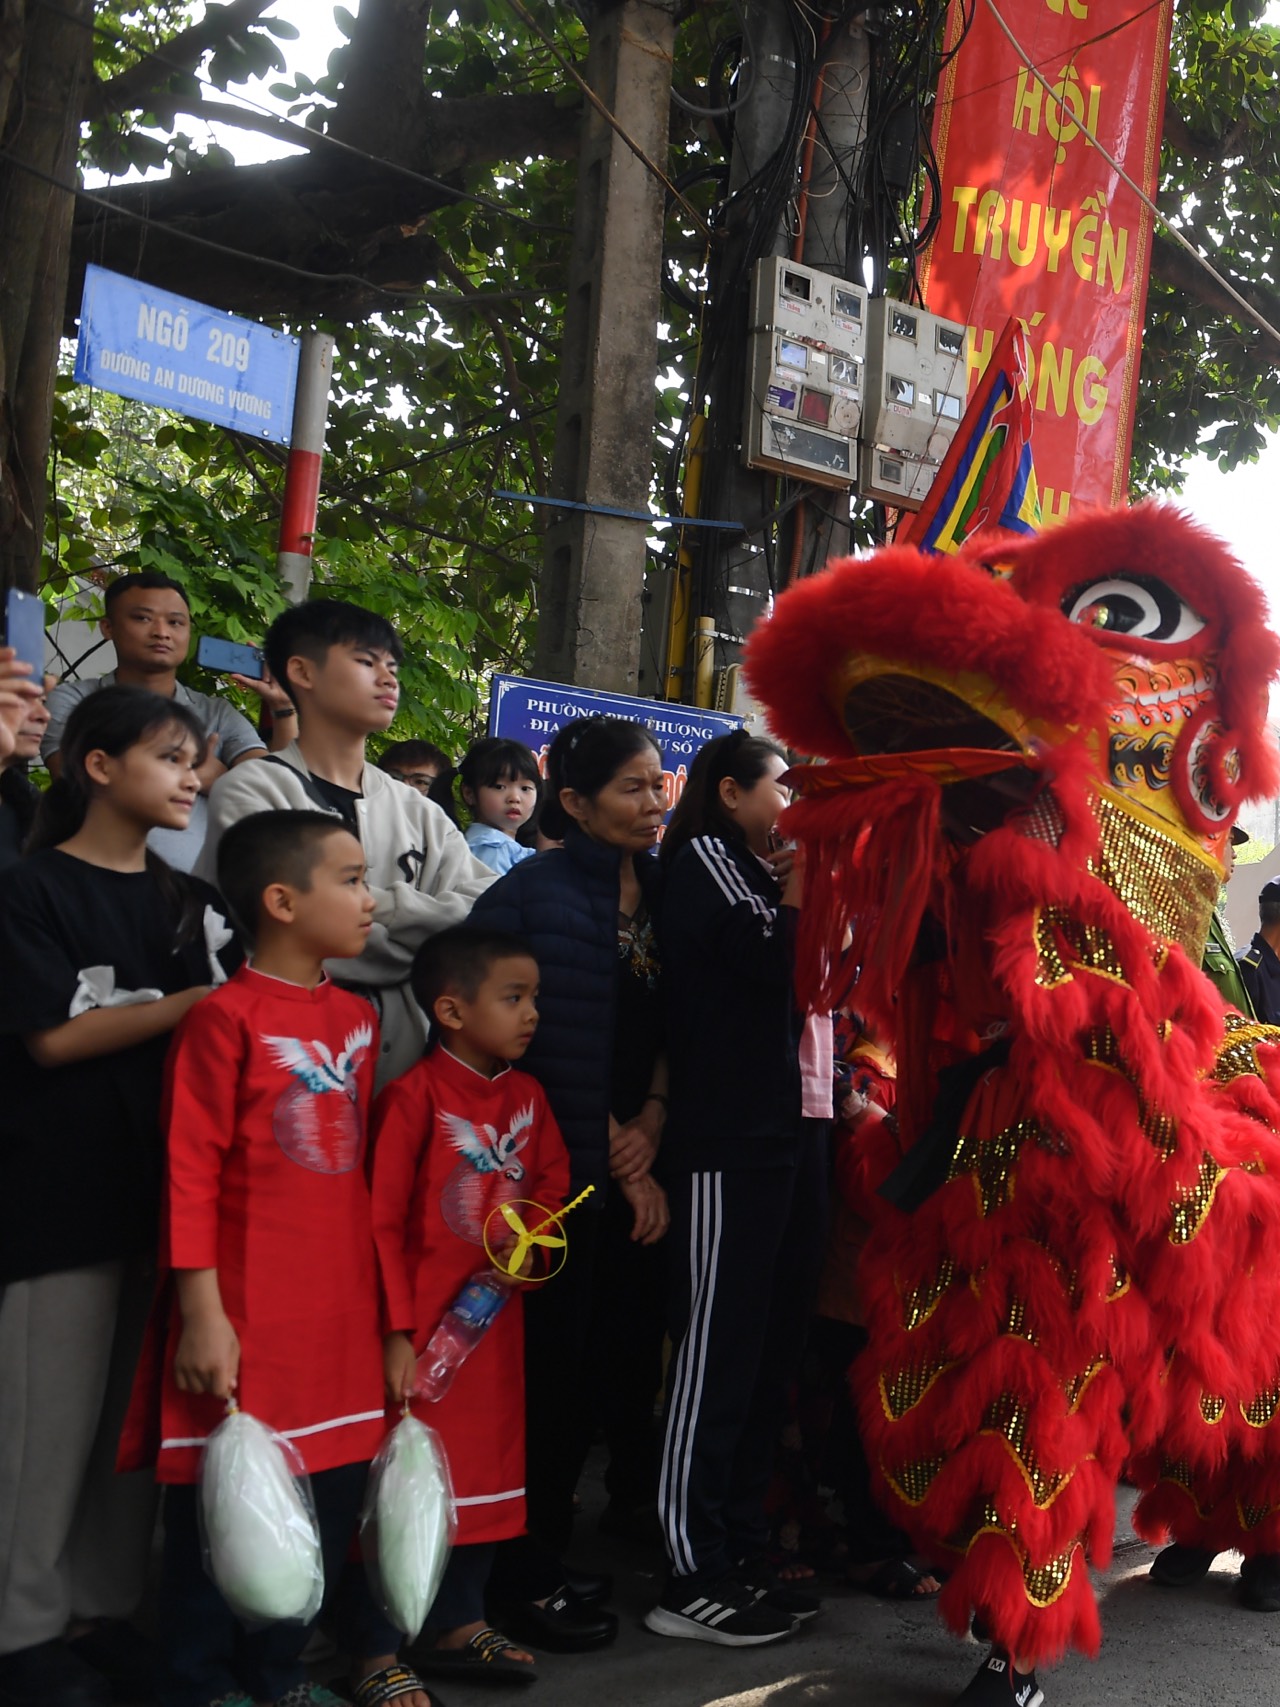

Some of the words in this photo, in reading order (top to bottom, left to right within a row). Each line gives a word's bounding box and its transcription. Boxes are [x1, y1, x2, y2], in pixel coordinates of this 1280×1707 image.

[1012, 65, 1101, 164] HỘI
[952, 186, 1128, 294] TRUYỀN
[137, 303, 189, 352] NGÕ
[206, 328, 250, 372] 209
[100, 349, 150, 381] ĐƯỜNG
[154, 367, 174, 390] AN
[178, 374, 225, 405] DƯƠNG
[229, 389, 272, 419] VƯƠNG
[527, 698, 601, 718] PHƯỜNG
[644, 718, 713, 740] THƯỢNG
[530, 718, 559, 734] ĐỊA
[671, 739, 693, 754] SỐ
